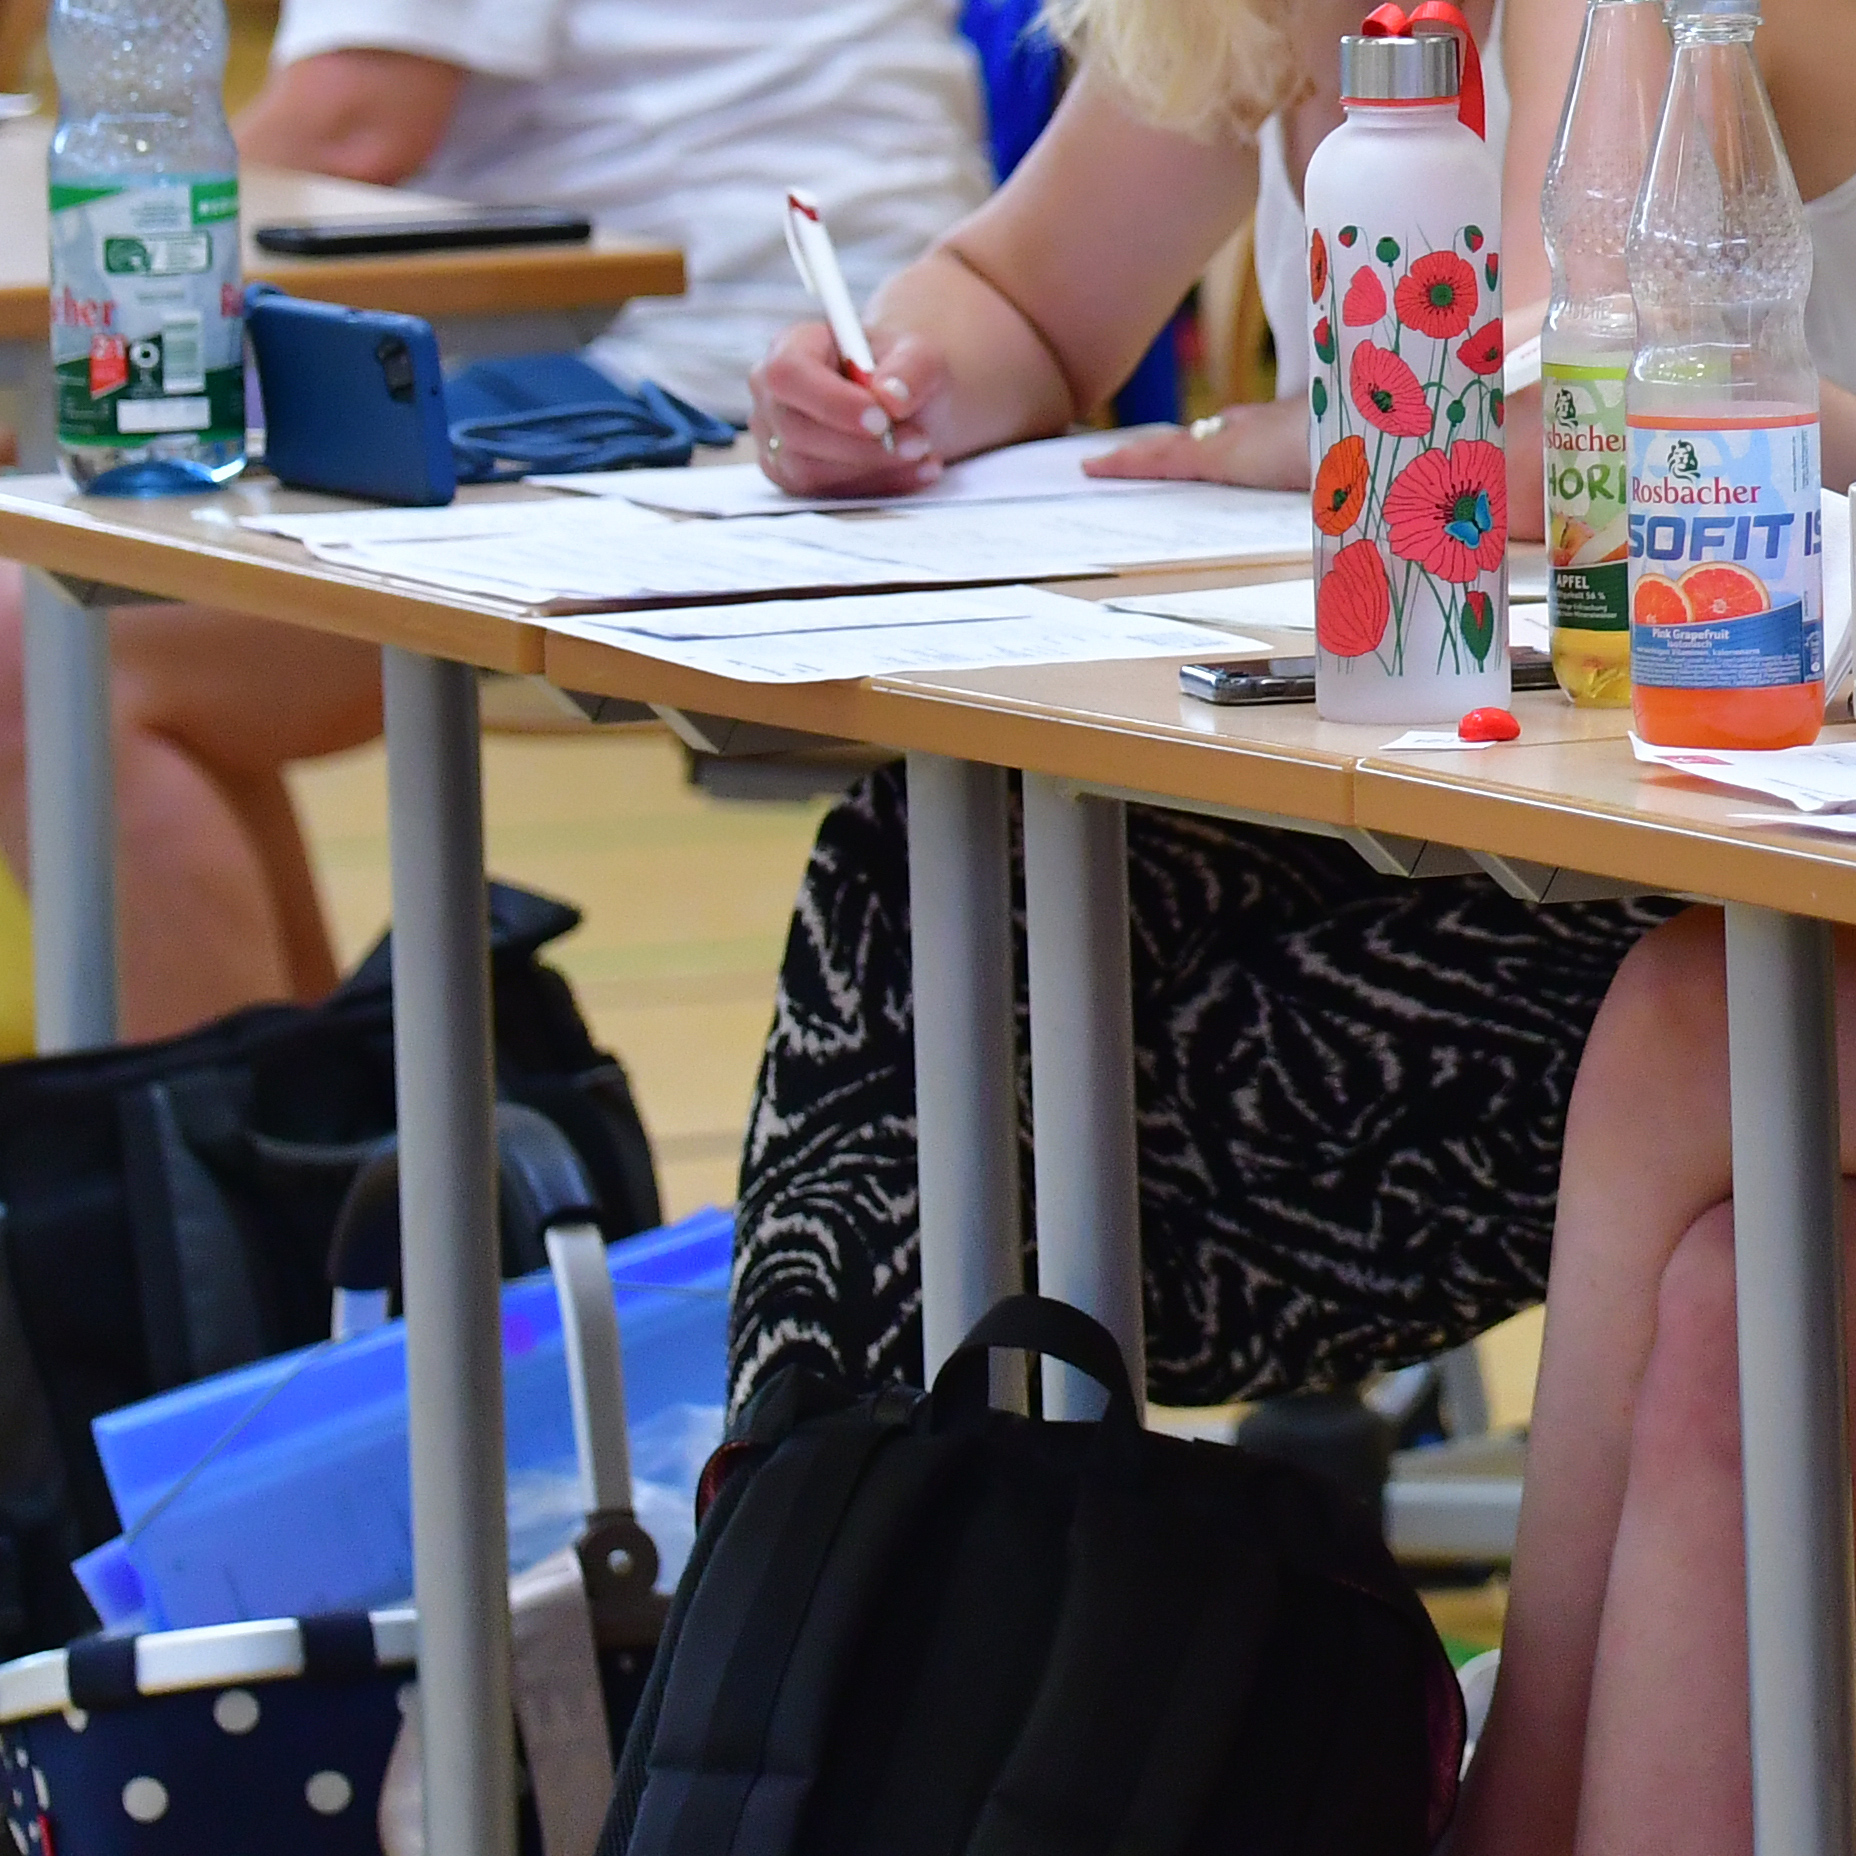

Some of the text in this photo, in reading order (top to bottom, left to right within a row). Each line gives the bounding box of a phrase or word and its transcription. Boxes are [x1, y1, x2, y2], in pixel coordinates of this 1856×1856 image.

[1632, 476, 1762, 505] Rosbacher
[1556, 573, 1590, 590] APFEL
[1652, 627, 1730, 641] Pink Grapefruit
